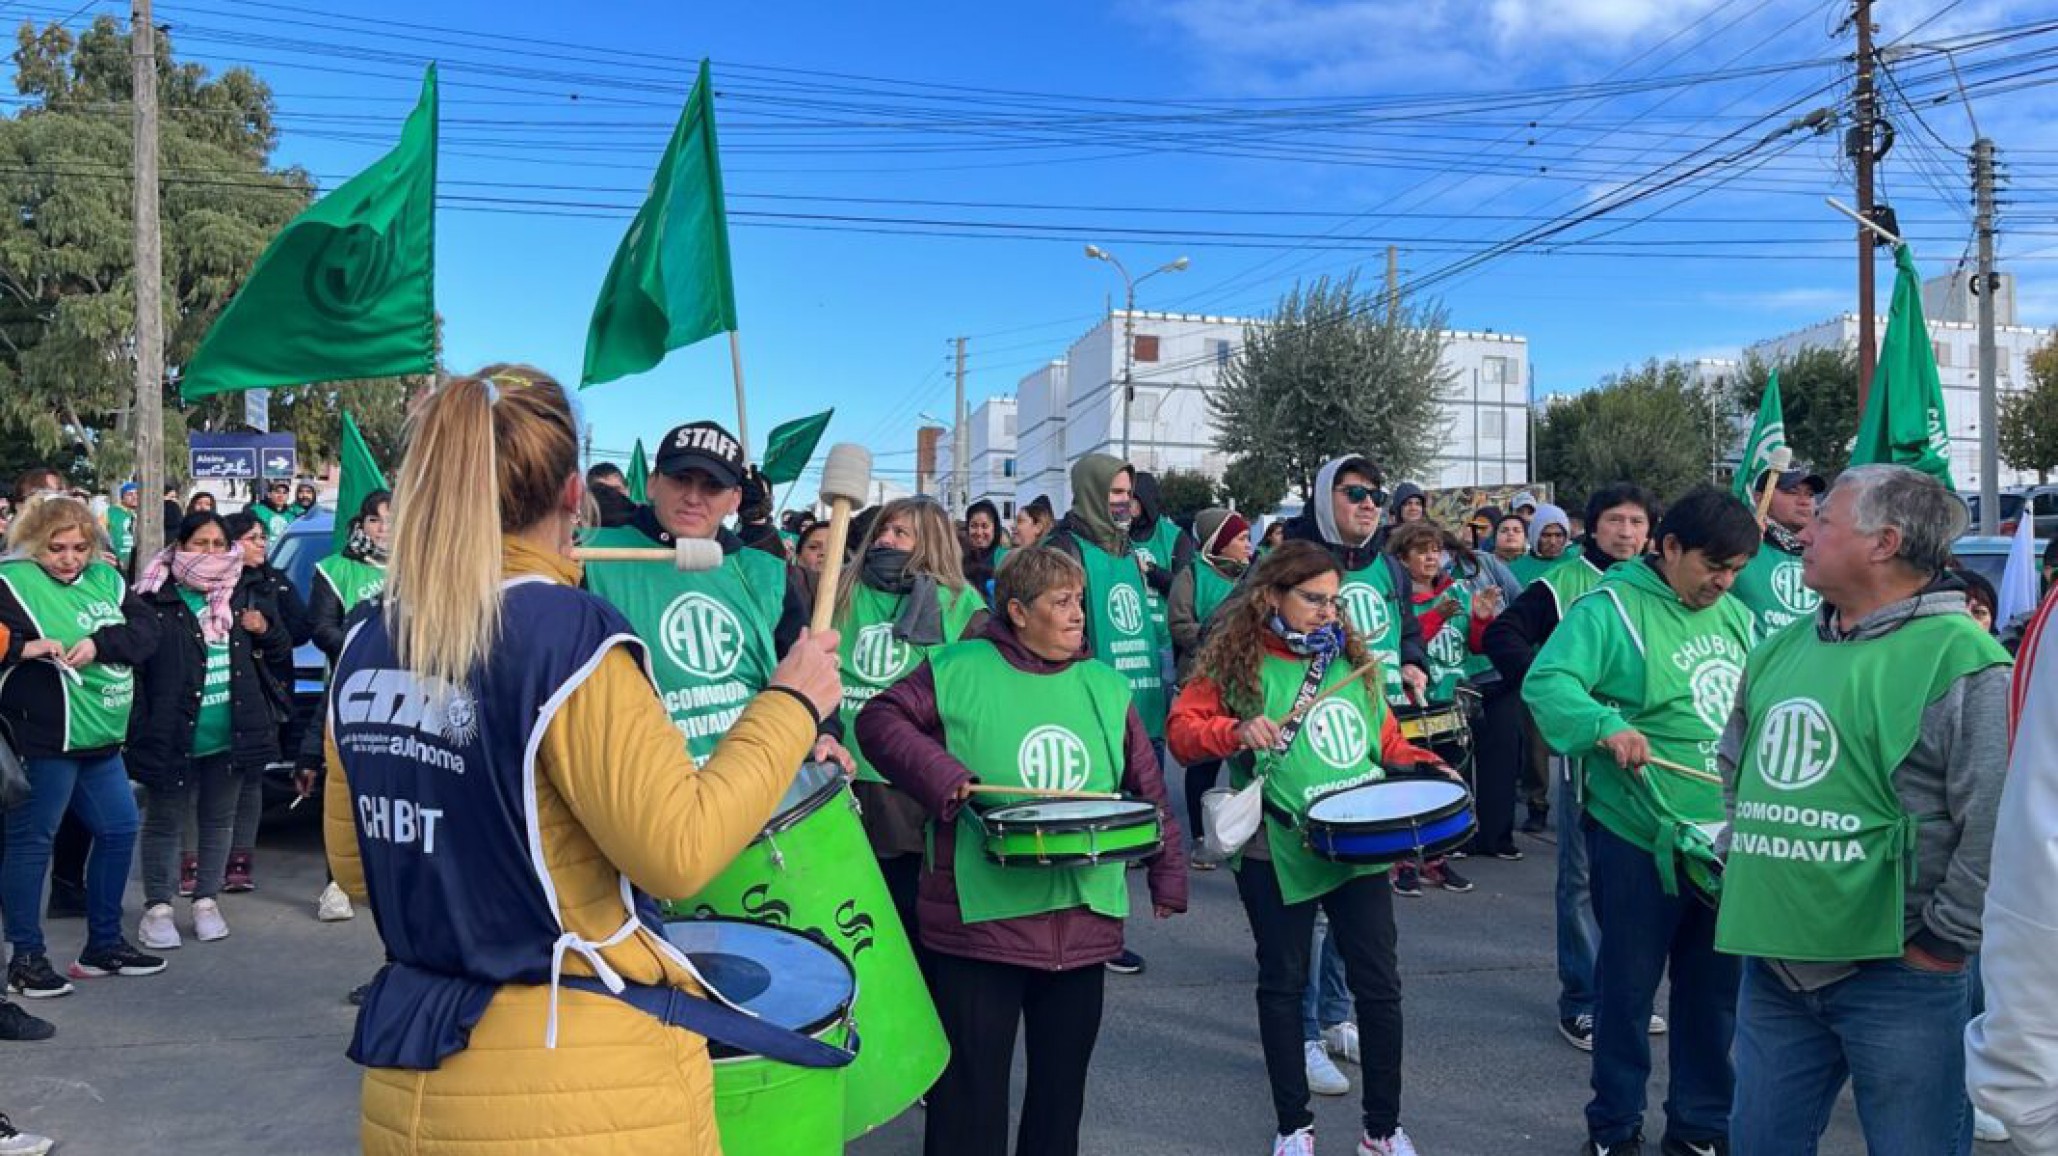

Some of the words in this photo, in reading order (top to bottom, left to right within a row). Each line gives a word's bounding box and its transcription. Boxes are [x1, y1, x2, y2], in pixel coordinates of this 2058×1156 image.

[674, 427, 738, 461] STAFF
[667, 597, 734, 672] ATE
[1671, 634, 1746, 672] CHUBU
[1310, 703, 1362, 764] ATE
[1758, 703, 1826, 782] ATE
[1024, 731, 1082, 798] ATE
[1735, 800, 1862, 833] COMODORO
[1730, 831, 1867, 863] RIVADAVIA
